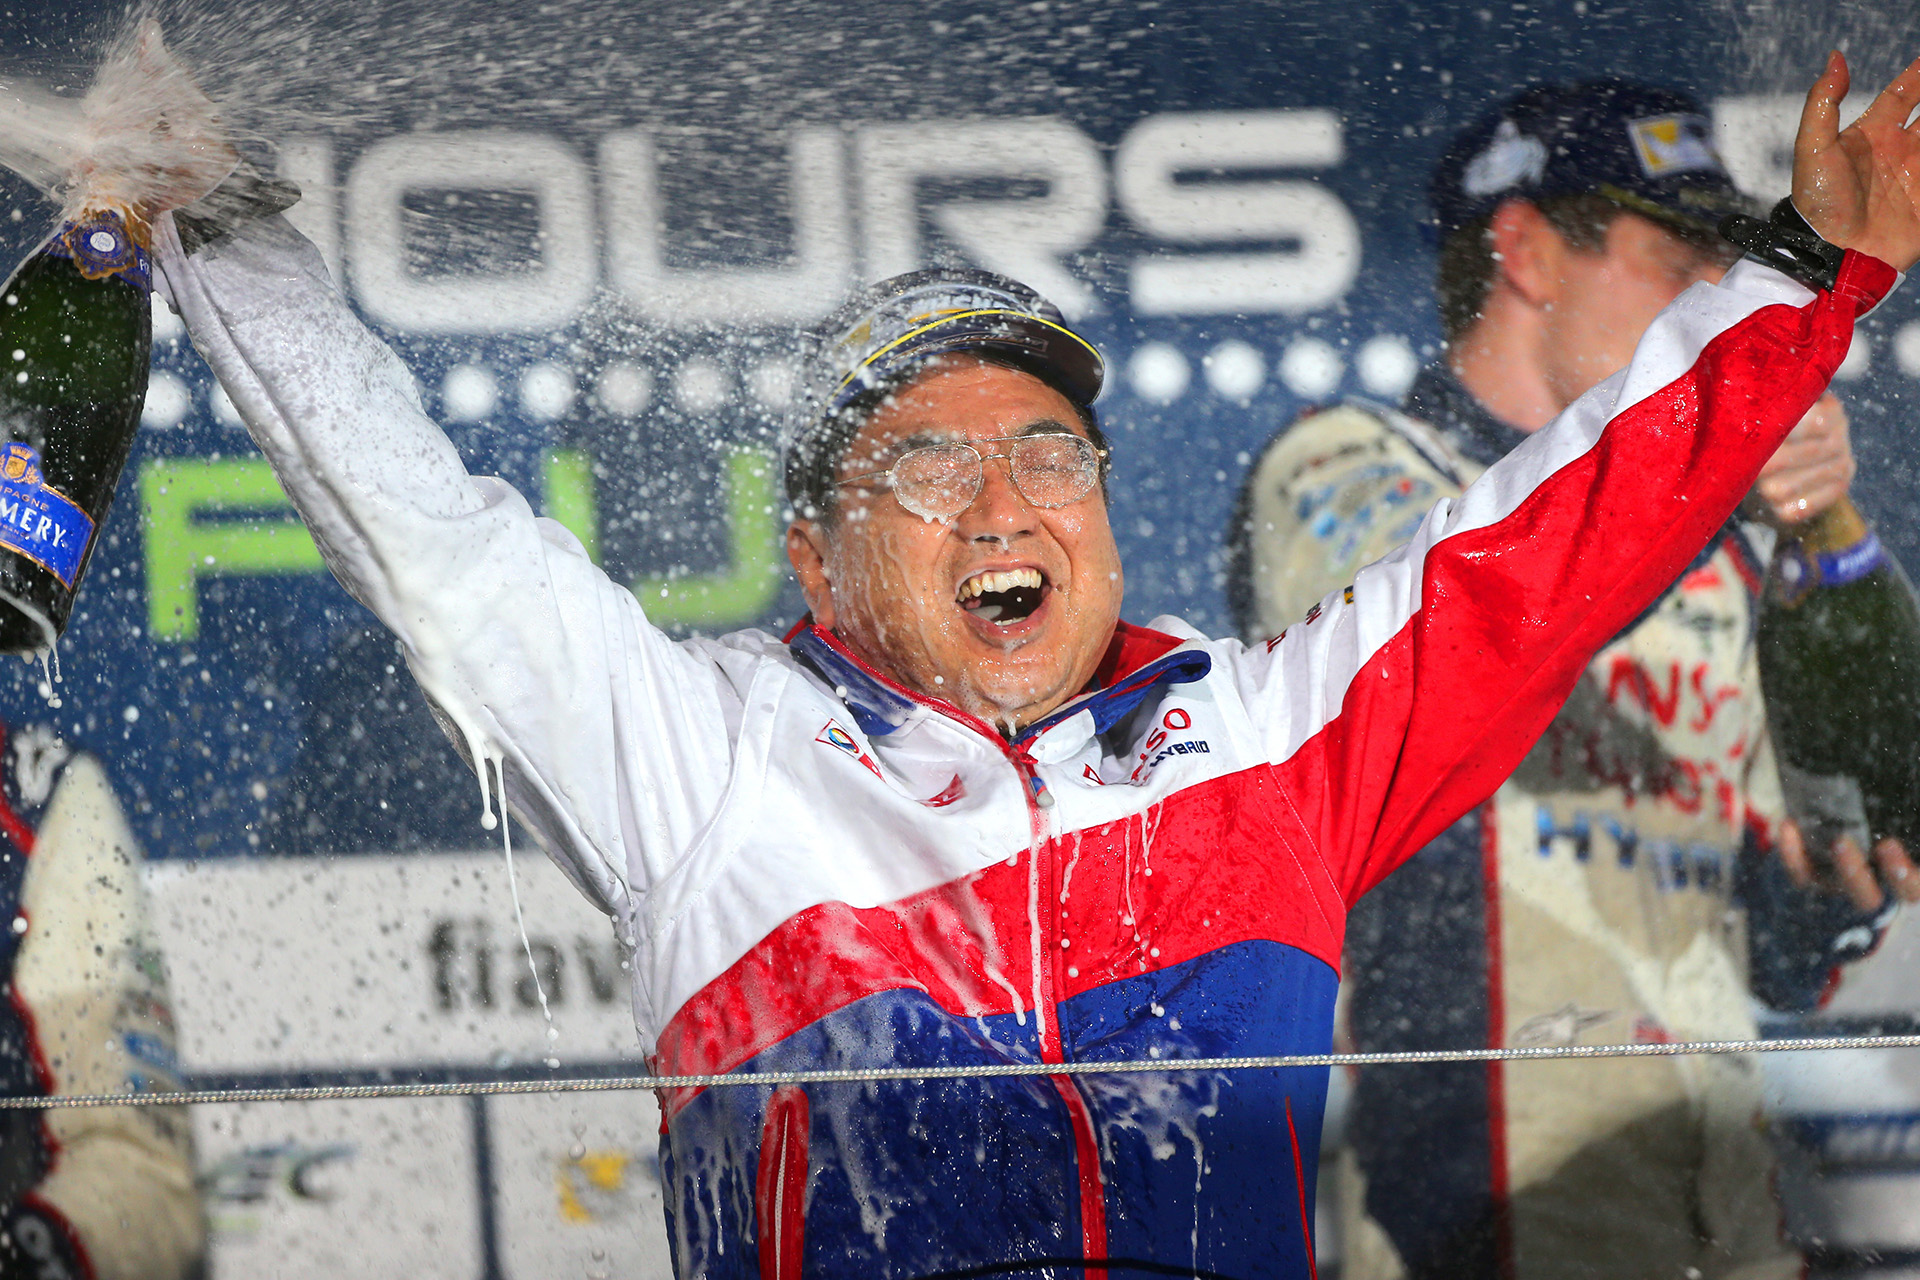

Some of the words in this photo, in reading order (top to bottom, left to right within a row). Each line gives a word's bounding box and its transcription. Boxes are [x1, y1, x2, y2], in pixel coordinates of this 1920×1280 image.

[280, 108, 1362, 335] OURS
[0, 485, 49, 512] PAGNE
[1150, 740, 1211, 768] HYBRID
